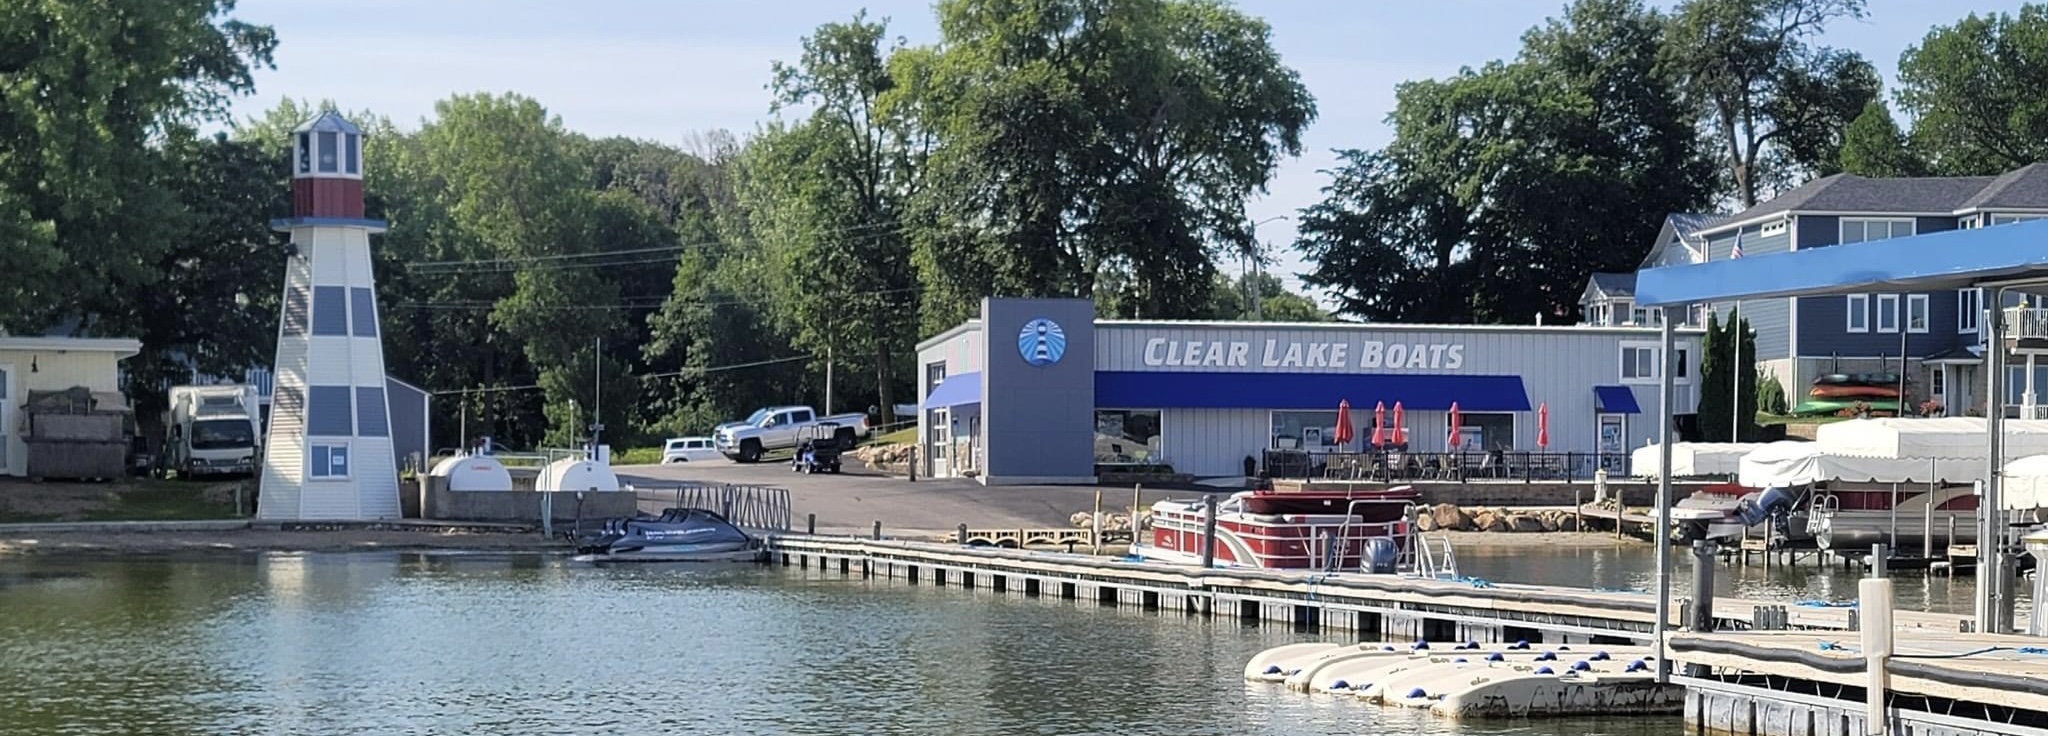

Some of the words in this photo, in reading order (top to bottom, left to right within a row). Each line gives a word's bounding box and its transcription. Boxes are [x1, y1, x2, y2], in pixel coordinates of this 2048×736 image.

[1143, 337, 1249, 367] CLEAR
[1261, 339, 1348, 368] LAKE
[1360, 340, 1464, 370] BOATS
